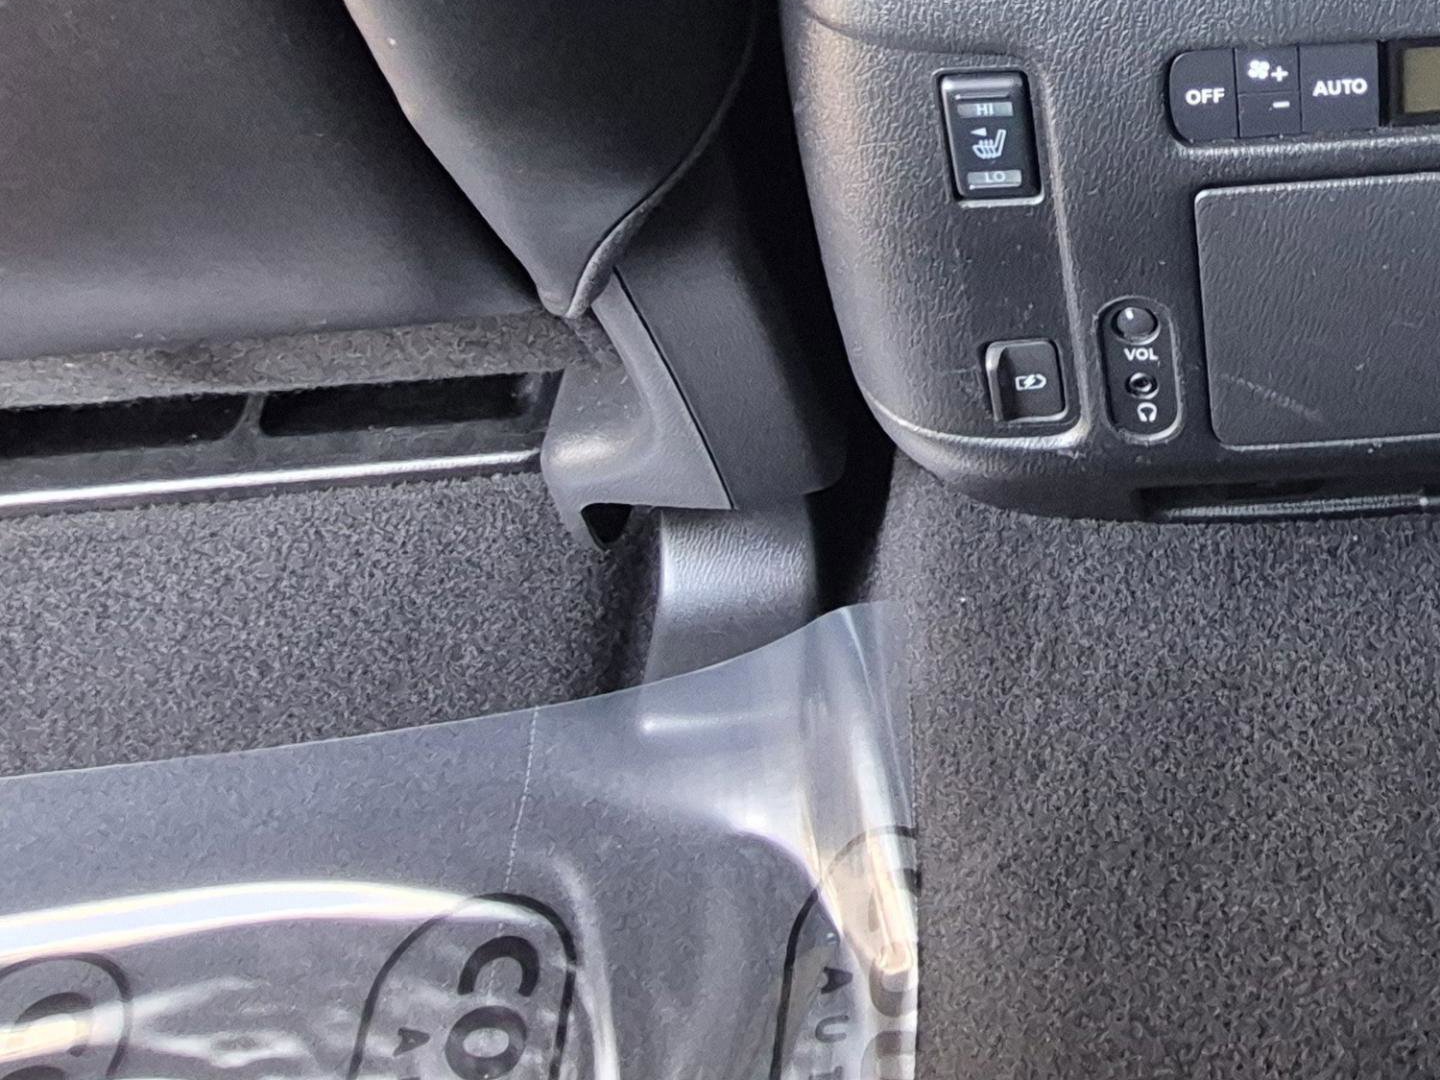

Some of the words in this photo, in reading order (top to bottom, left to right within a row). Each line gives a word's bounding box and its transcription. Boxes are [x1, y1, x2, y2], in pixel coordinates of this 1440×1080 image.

[1312, 77, 1368, 98] AUTO
[1185, 86, 1225, 106] OFF
[975, 103, 994, 116] HI
[984, 170, 1006, 183] LO
[1123, 347, 1159, 362] VOL
